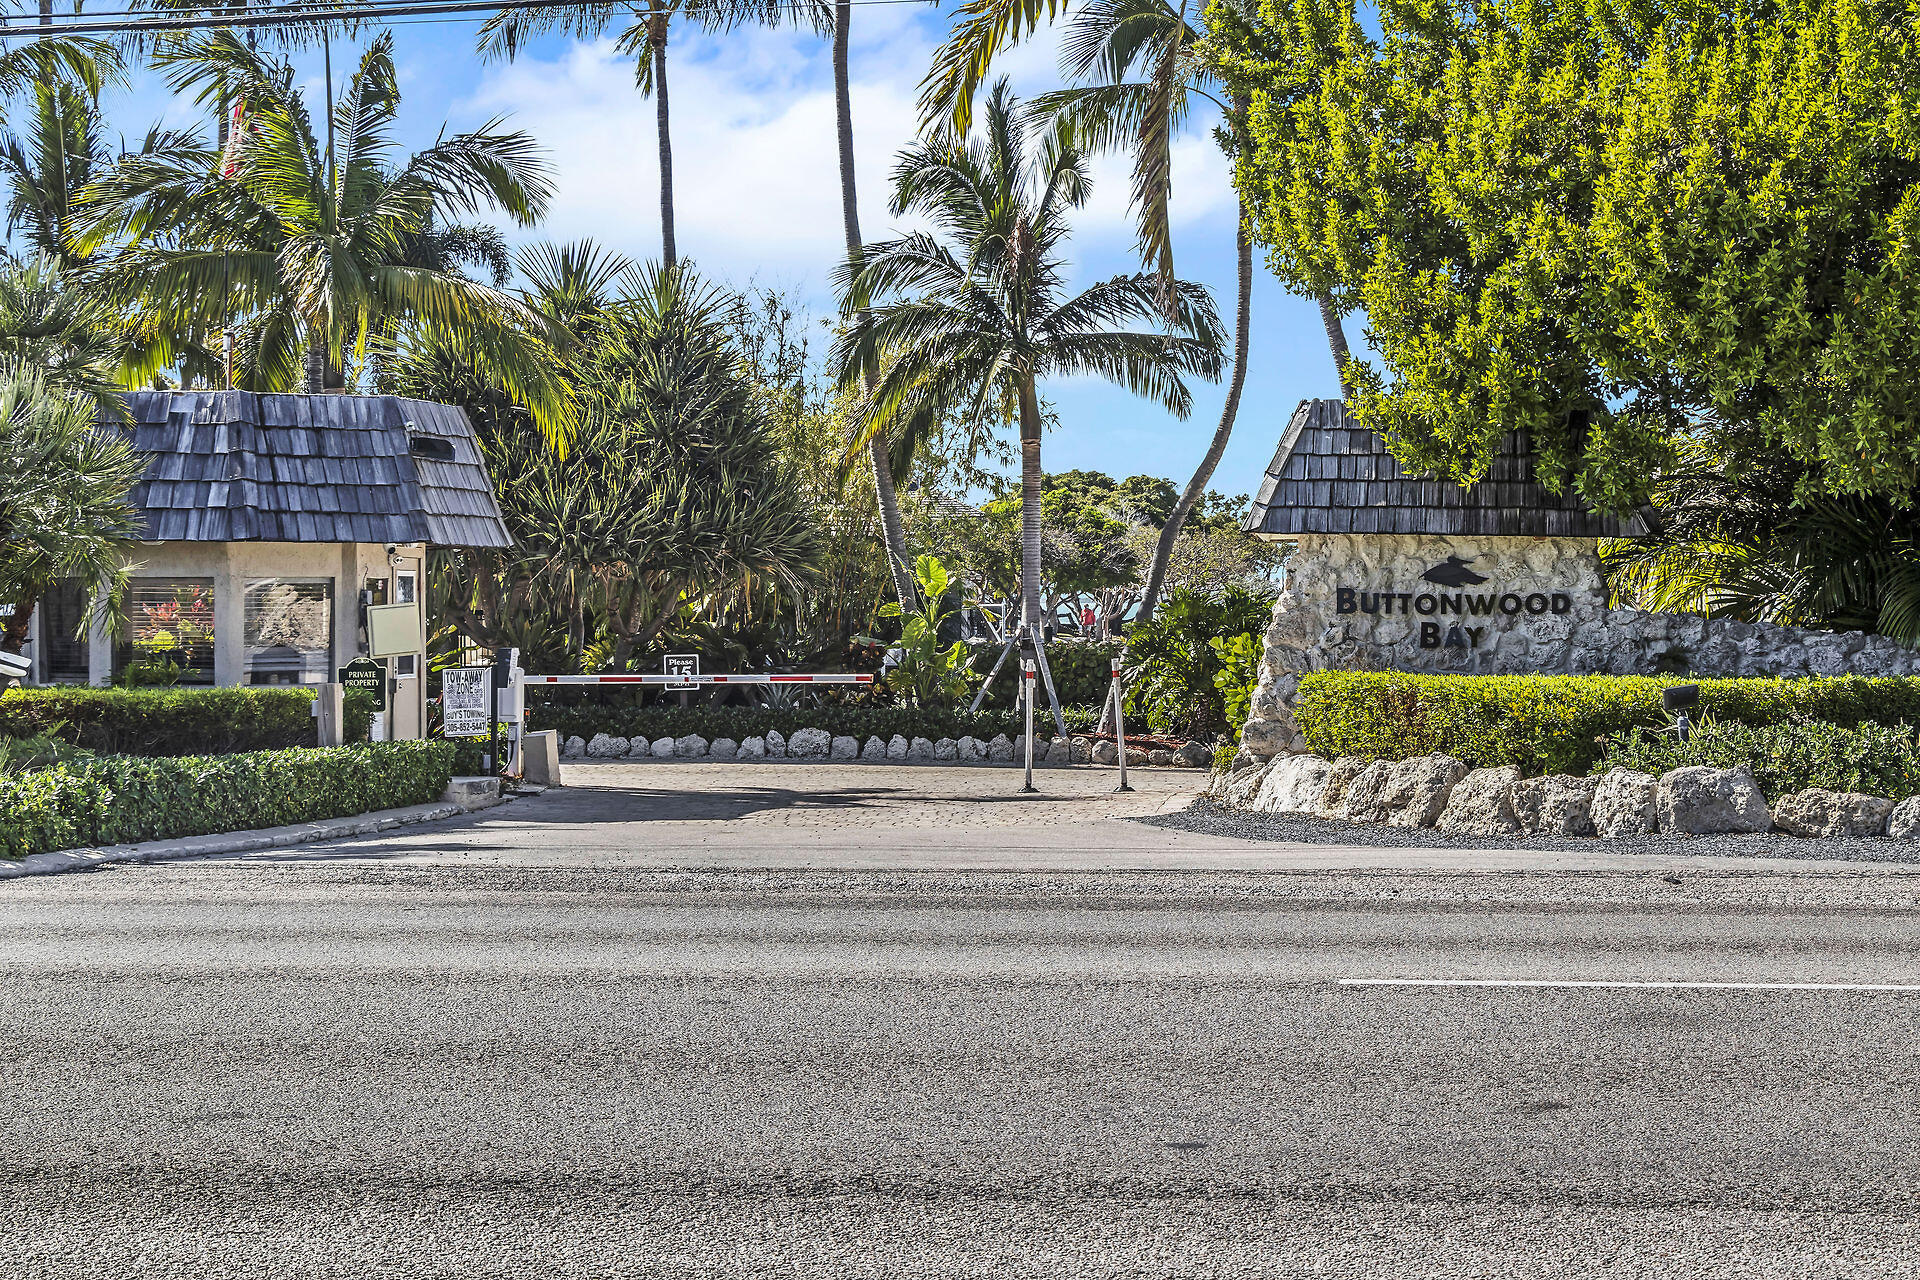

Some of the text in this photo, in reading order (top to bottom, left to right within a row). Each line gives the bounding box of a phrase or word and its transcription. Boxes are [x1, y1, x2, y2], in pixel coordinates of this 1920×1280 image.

[1336, 587, 1571, 615] BUTTONWOOD
[1420, 622, 1484, 649] BAY
[671, 666, 691, 676] 15
[446, 671, 483, 683] TOW-AWAY
[457, 683, 473, 694] ZONE
[447, 709, 485, 719] GUY'S TOWING
[446, 722, 485, 732] 305-852-5447
